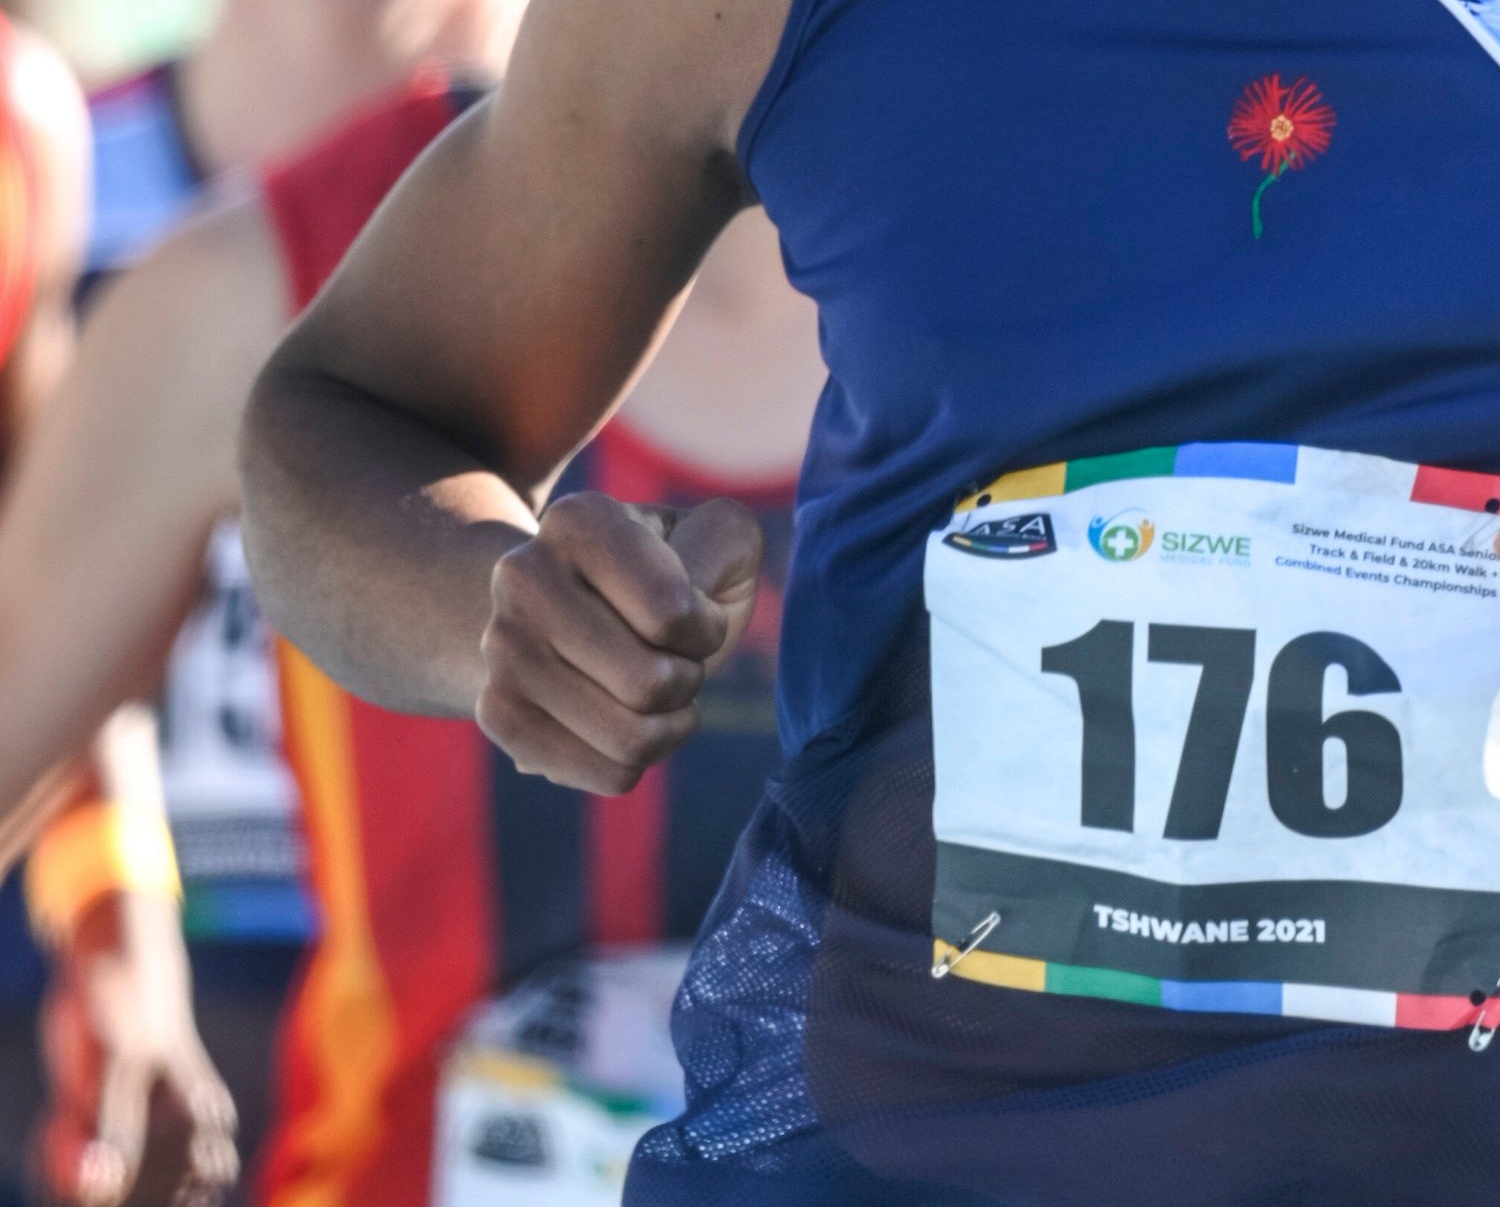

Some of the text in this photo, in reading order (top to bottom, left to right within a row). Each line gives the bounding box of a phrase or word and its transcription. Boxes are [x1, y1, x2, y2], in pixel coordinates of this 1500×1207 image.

[1161, 531, 1251, 557] SIZWE
[1292, 523, 1330, 538] Sizwe
[1334, 528, 1387, 546] Medical
[1390, 536, 1425, 551] Fund
[1428, 542, 1455, 555] ASA
[1275, 555, 1497, 599] Combined Events Championships
[1310, 543, 1346, 559] Track
[1350, 550, 1359, 560] &
[1363, 551, 1396, 566] Field
[1399, 556, 1408, 567] &
[1412, 558, 1450, 573] 20km
[1455, 562, 1487, 578] Walk
[1041, 619, 1403, 841] 176
[1093, 903, 1326, 944] TSHWANE 2021
